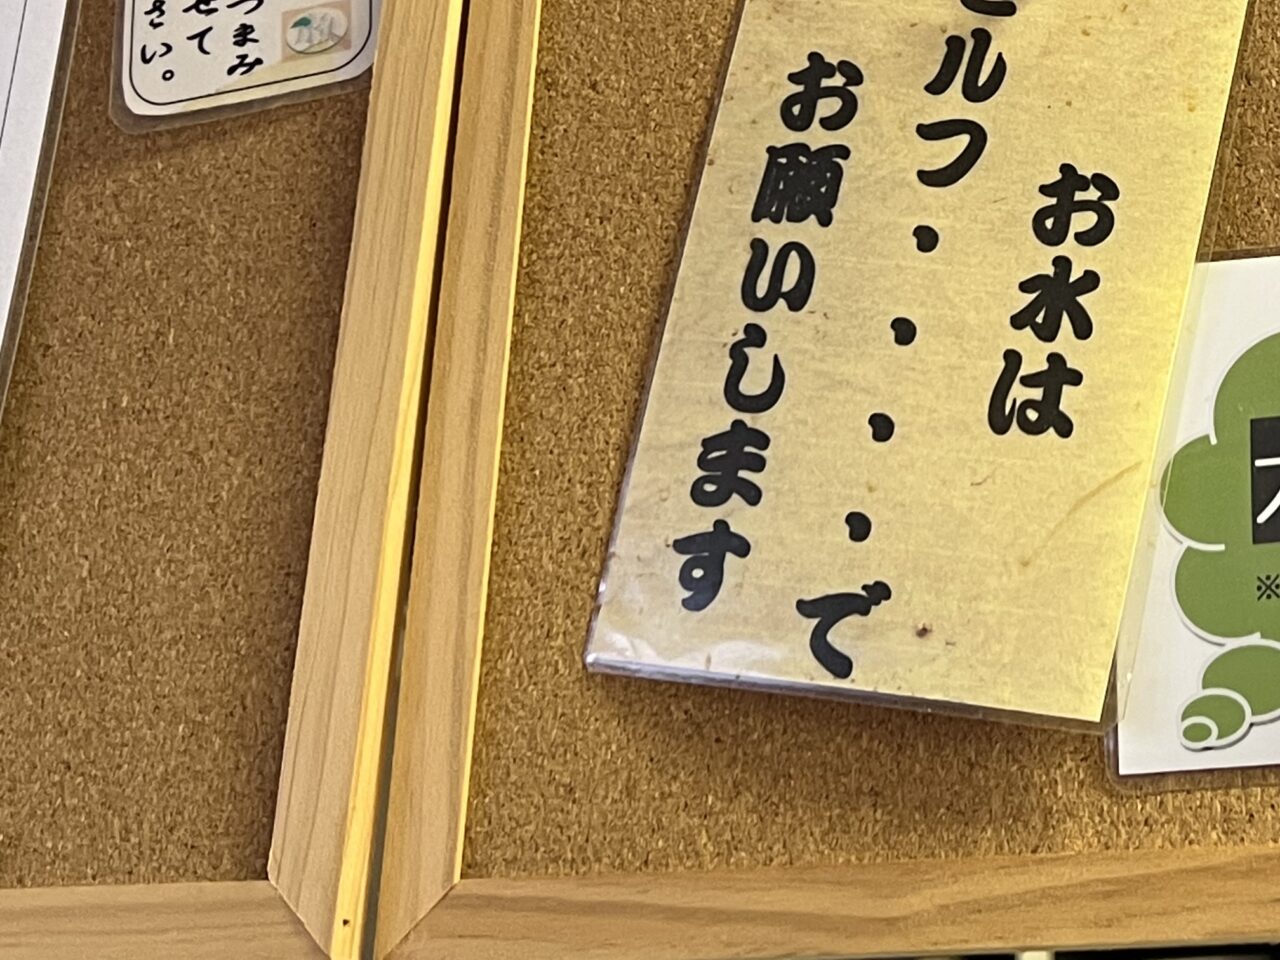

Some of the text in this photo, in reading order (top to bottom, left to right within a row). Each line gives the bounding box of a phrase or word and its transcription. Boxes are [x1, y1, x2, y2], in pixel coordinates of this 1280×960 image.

[672, 52, 864, 612] お願いします
[988, 163, 1120, 439] お水は
